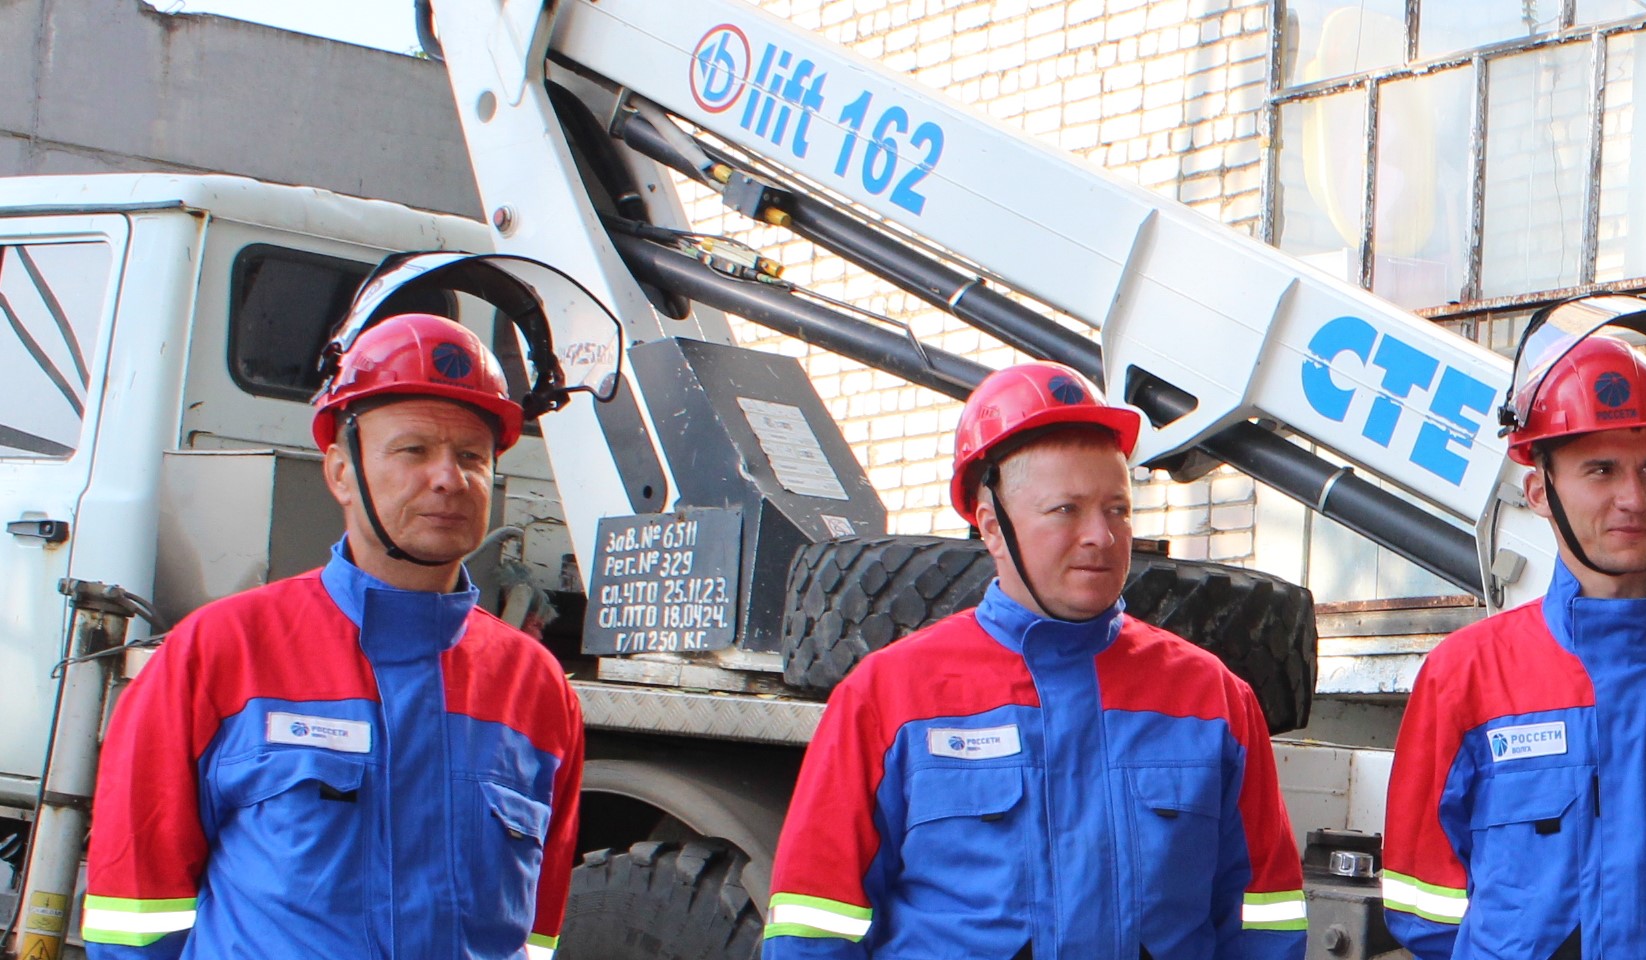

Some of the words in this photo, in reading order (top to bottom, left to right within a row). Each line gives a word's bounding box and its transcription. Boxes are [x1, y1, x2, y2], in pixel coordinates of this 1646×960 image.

[740, 42, 828, 159] lift
[834, 90, 945, 217] 162
[1302, 316, 1498, 487] CTE
[660, 550, 694, 577] 329
[647, 630, 678, 652] 250
[967, 736, 1001, 746] РОССЕТИ
[1511, 730, 1563, 744] РОССЕТИ
[1511, 745, 1532, 755] ВОЛГА
